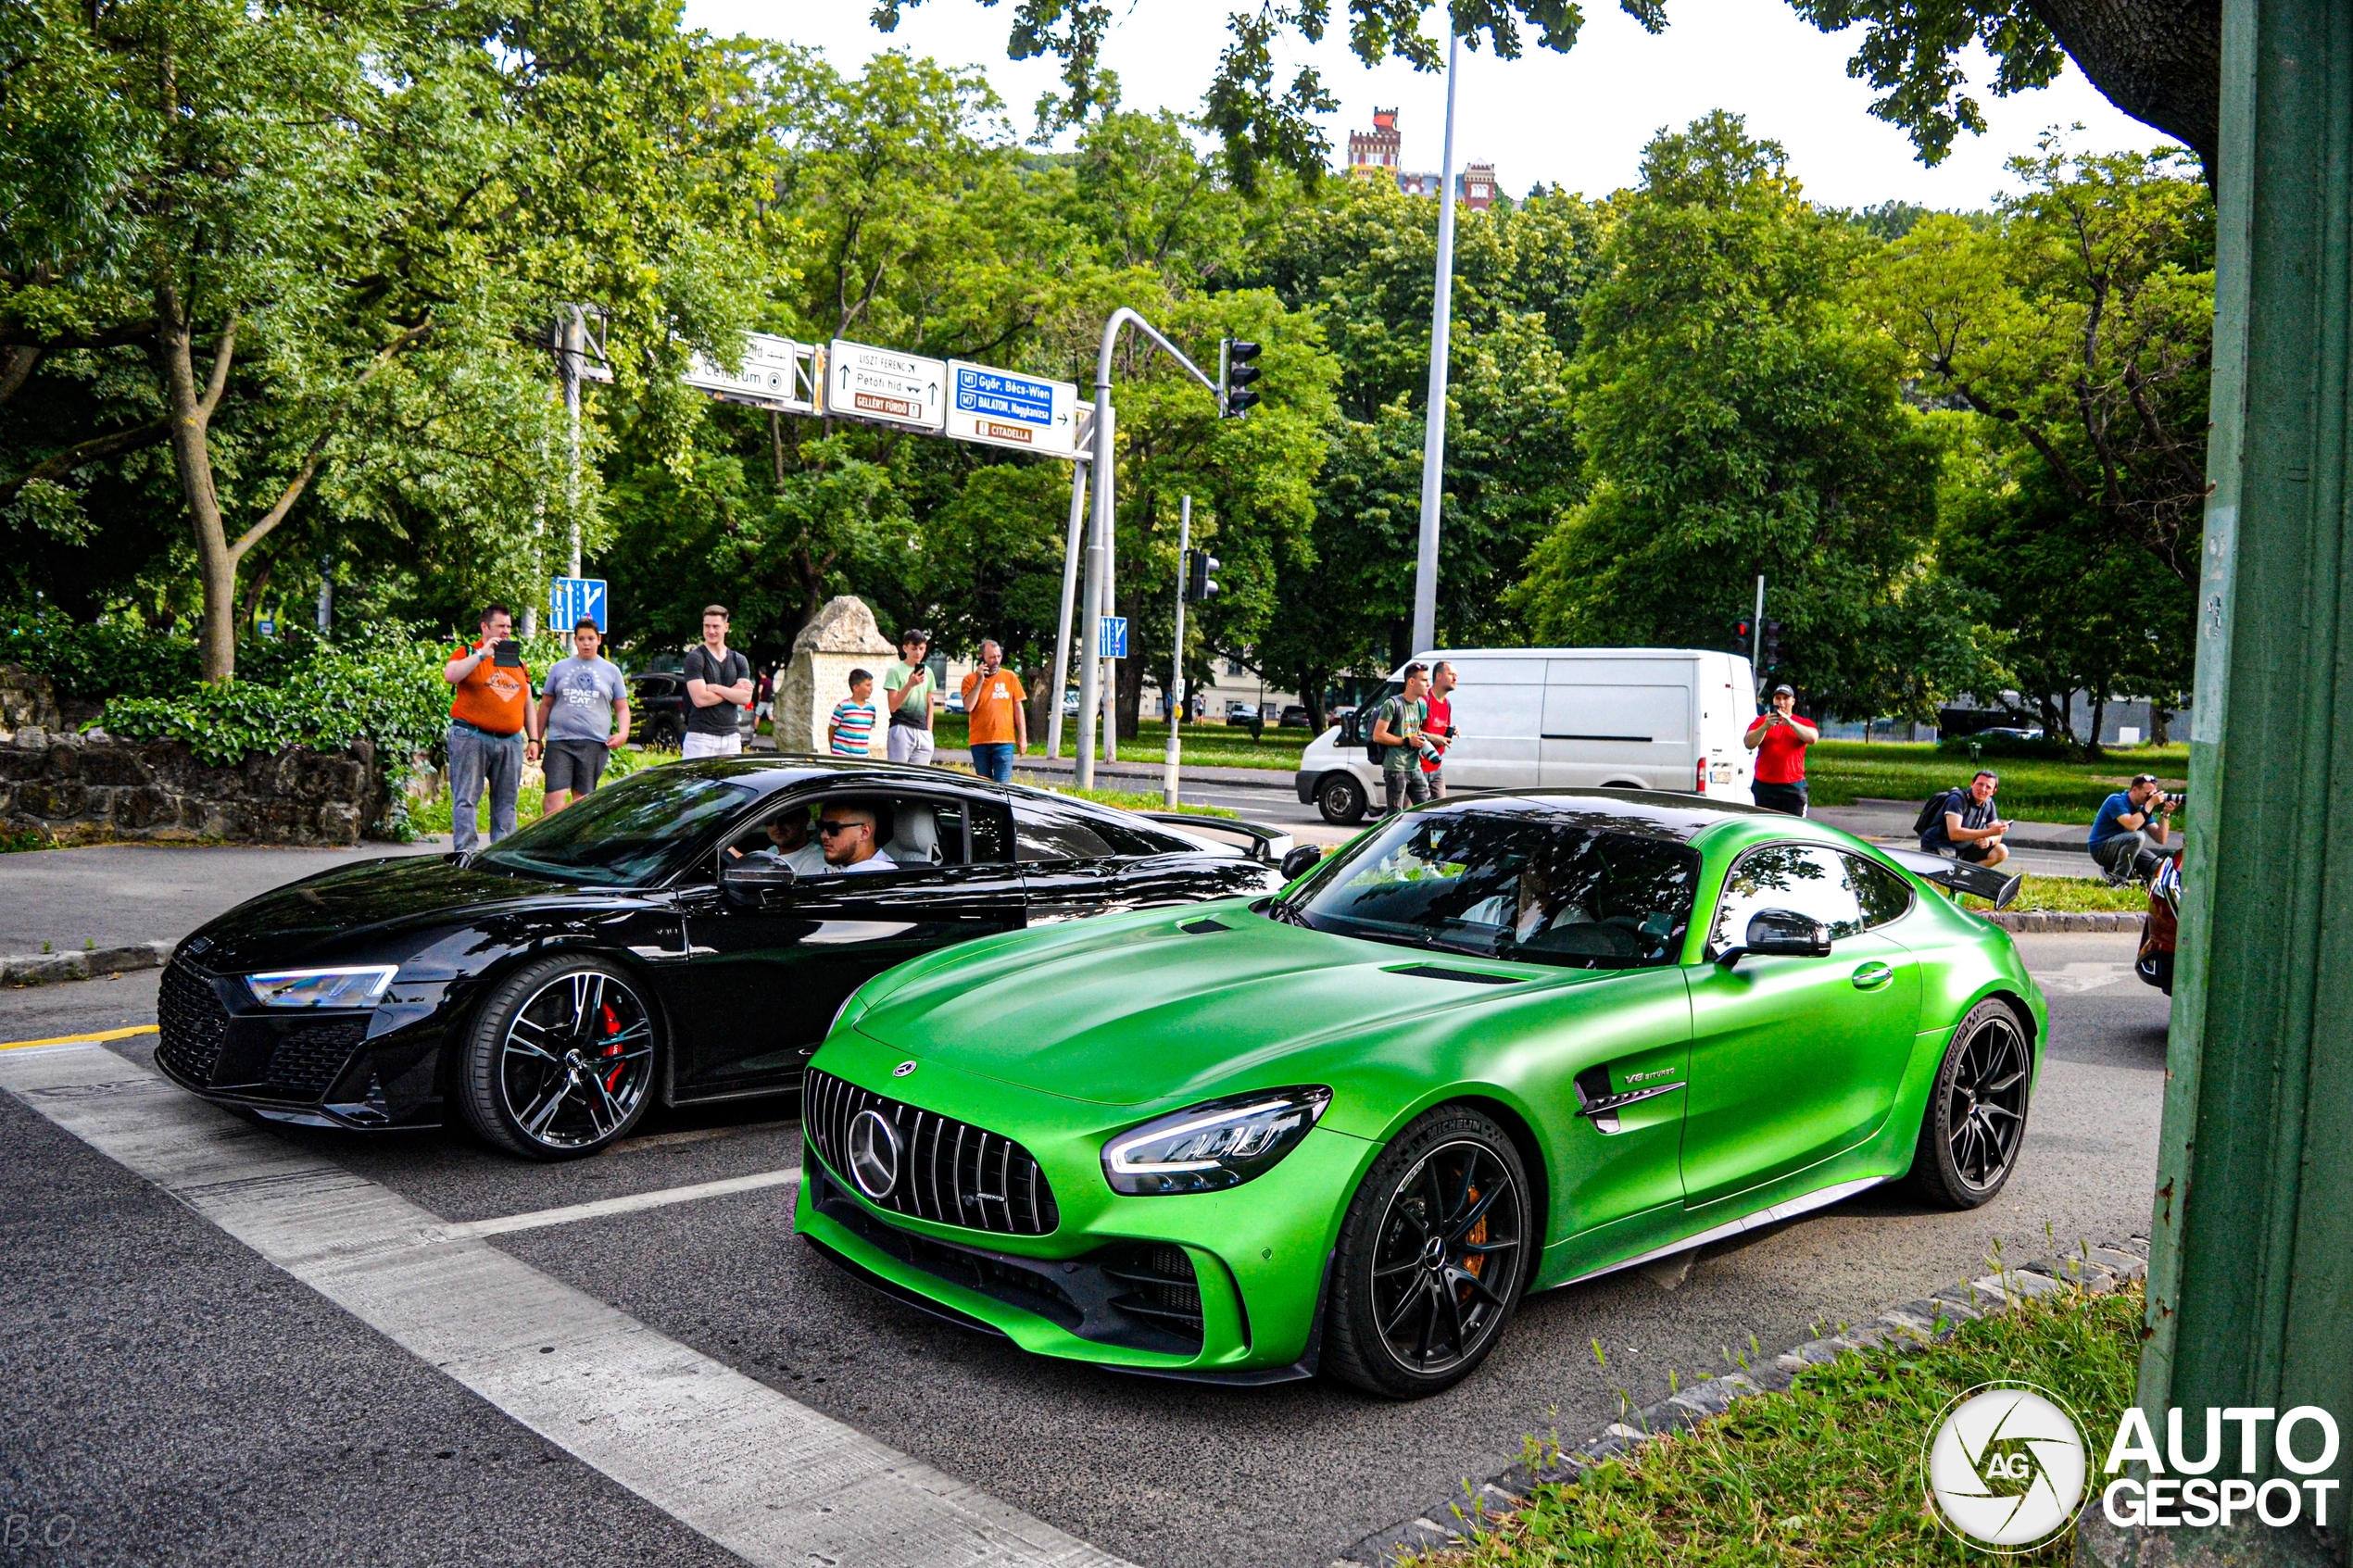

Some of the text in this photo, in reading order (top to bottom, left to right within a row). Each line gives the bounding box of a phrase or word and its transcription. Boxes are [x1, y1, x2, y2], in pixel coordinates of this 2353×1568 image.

[859, 354, 905, 371] LISZT FERENC
[964, 373, 974, 384] M1
[1005, 380, 1050, 399] Bécs-Wien
[857, 395, 884, 410] GELLÉRT
[963, 395, 1049, 420] M7 BALATON, Nagykanizsa
[991, 425, 1029, 441] CITADELLA
[562, 688, 600, 699] SPACE
[569, 696, 591, 705] CAT
[1624, 1067, 1675, 1084] V8 BITURBO
[1427, 1119, 1481, 1140] MICHELIN
